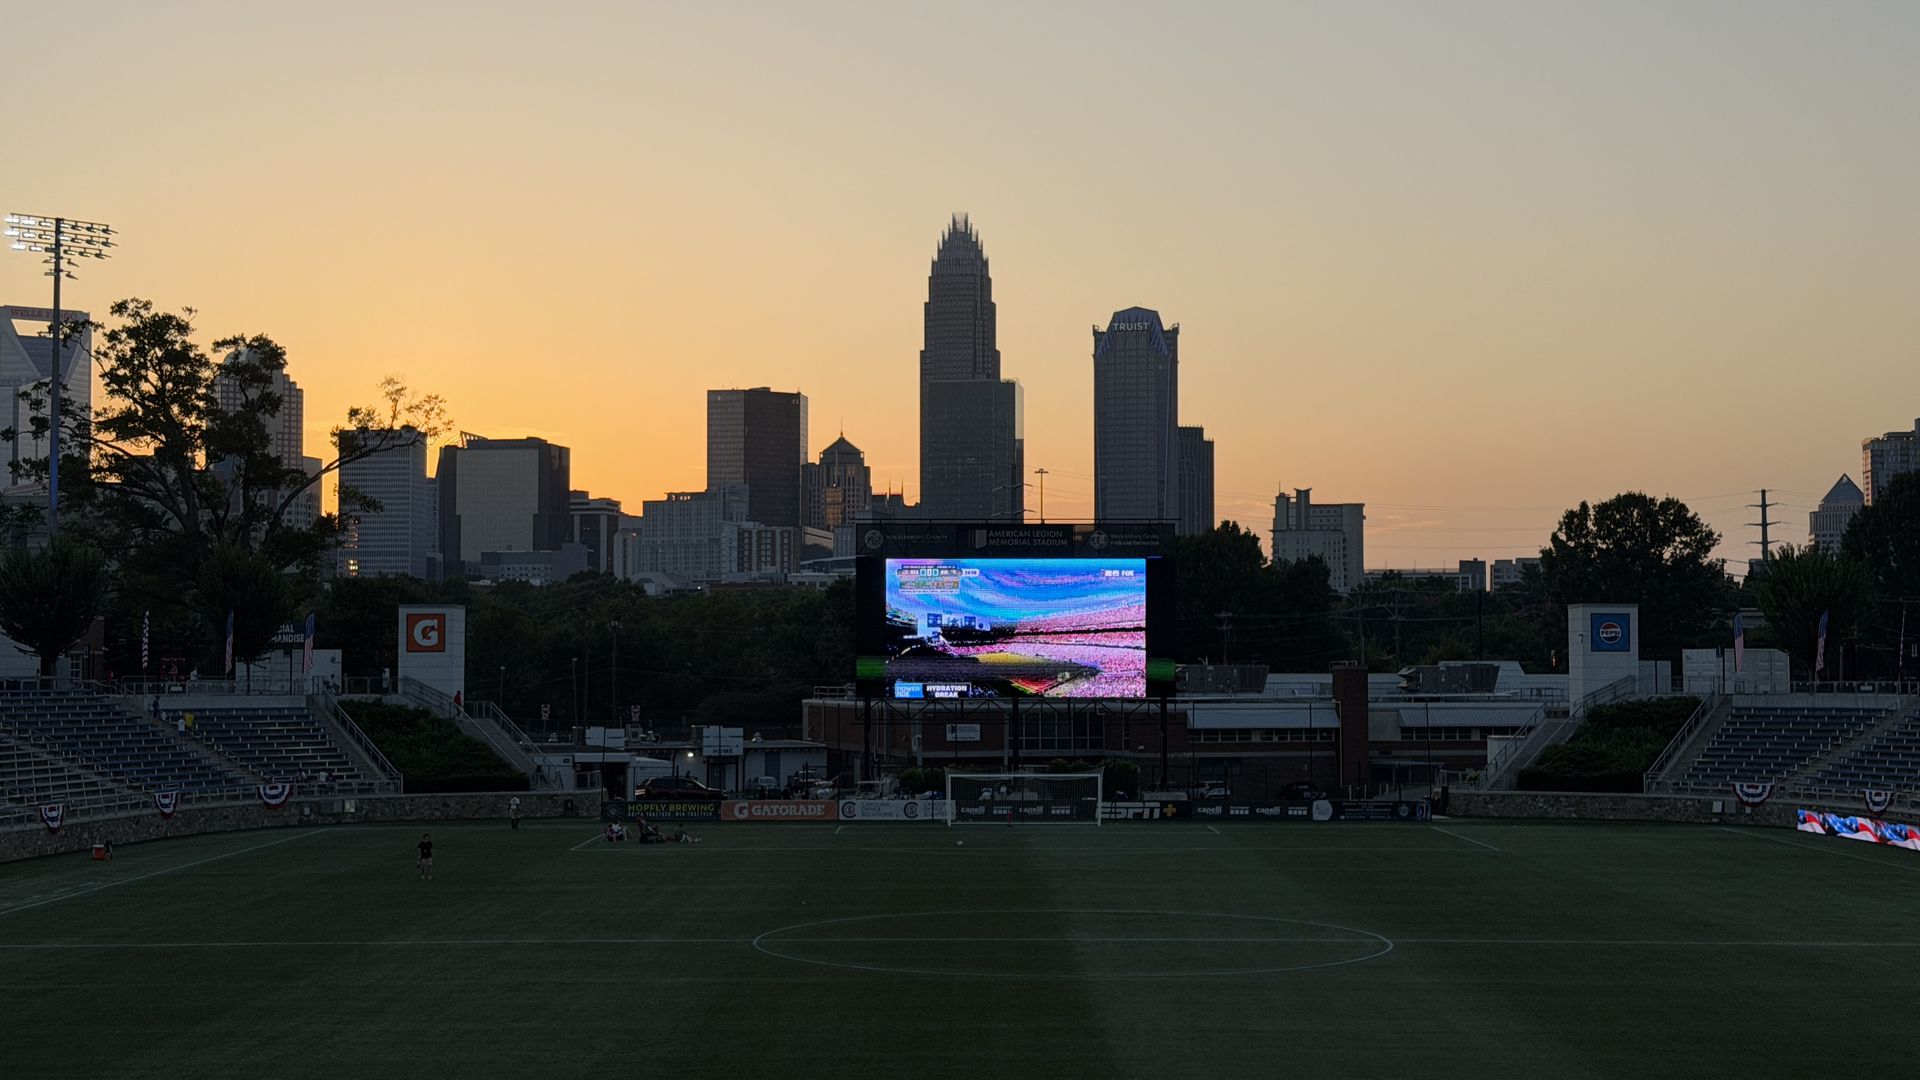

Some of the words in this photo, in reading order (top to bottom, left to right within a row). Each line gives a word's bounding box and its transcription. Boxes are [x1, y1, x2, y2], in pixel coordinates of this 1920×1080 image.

[1112, 322, 1150, 331] TRUIST
[988, 530, 1031, 538] AMERICAN
[1033, 530, 1063, 538] LEGION
[989, 538, 1031, 546] MEMORIAL
[1033, 538, 1068, 546] STADIUM
[413, 619, 438, 647] G
[628, 803, 668, 812] HOPFLY
[669, 803, 715, 812] BREWING
[752, 804, 825, 816] GATORADE
